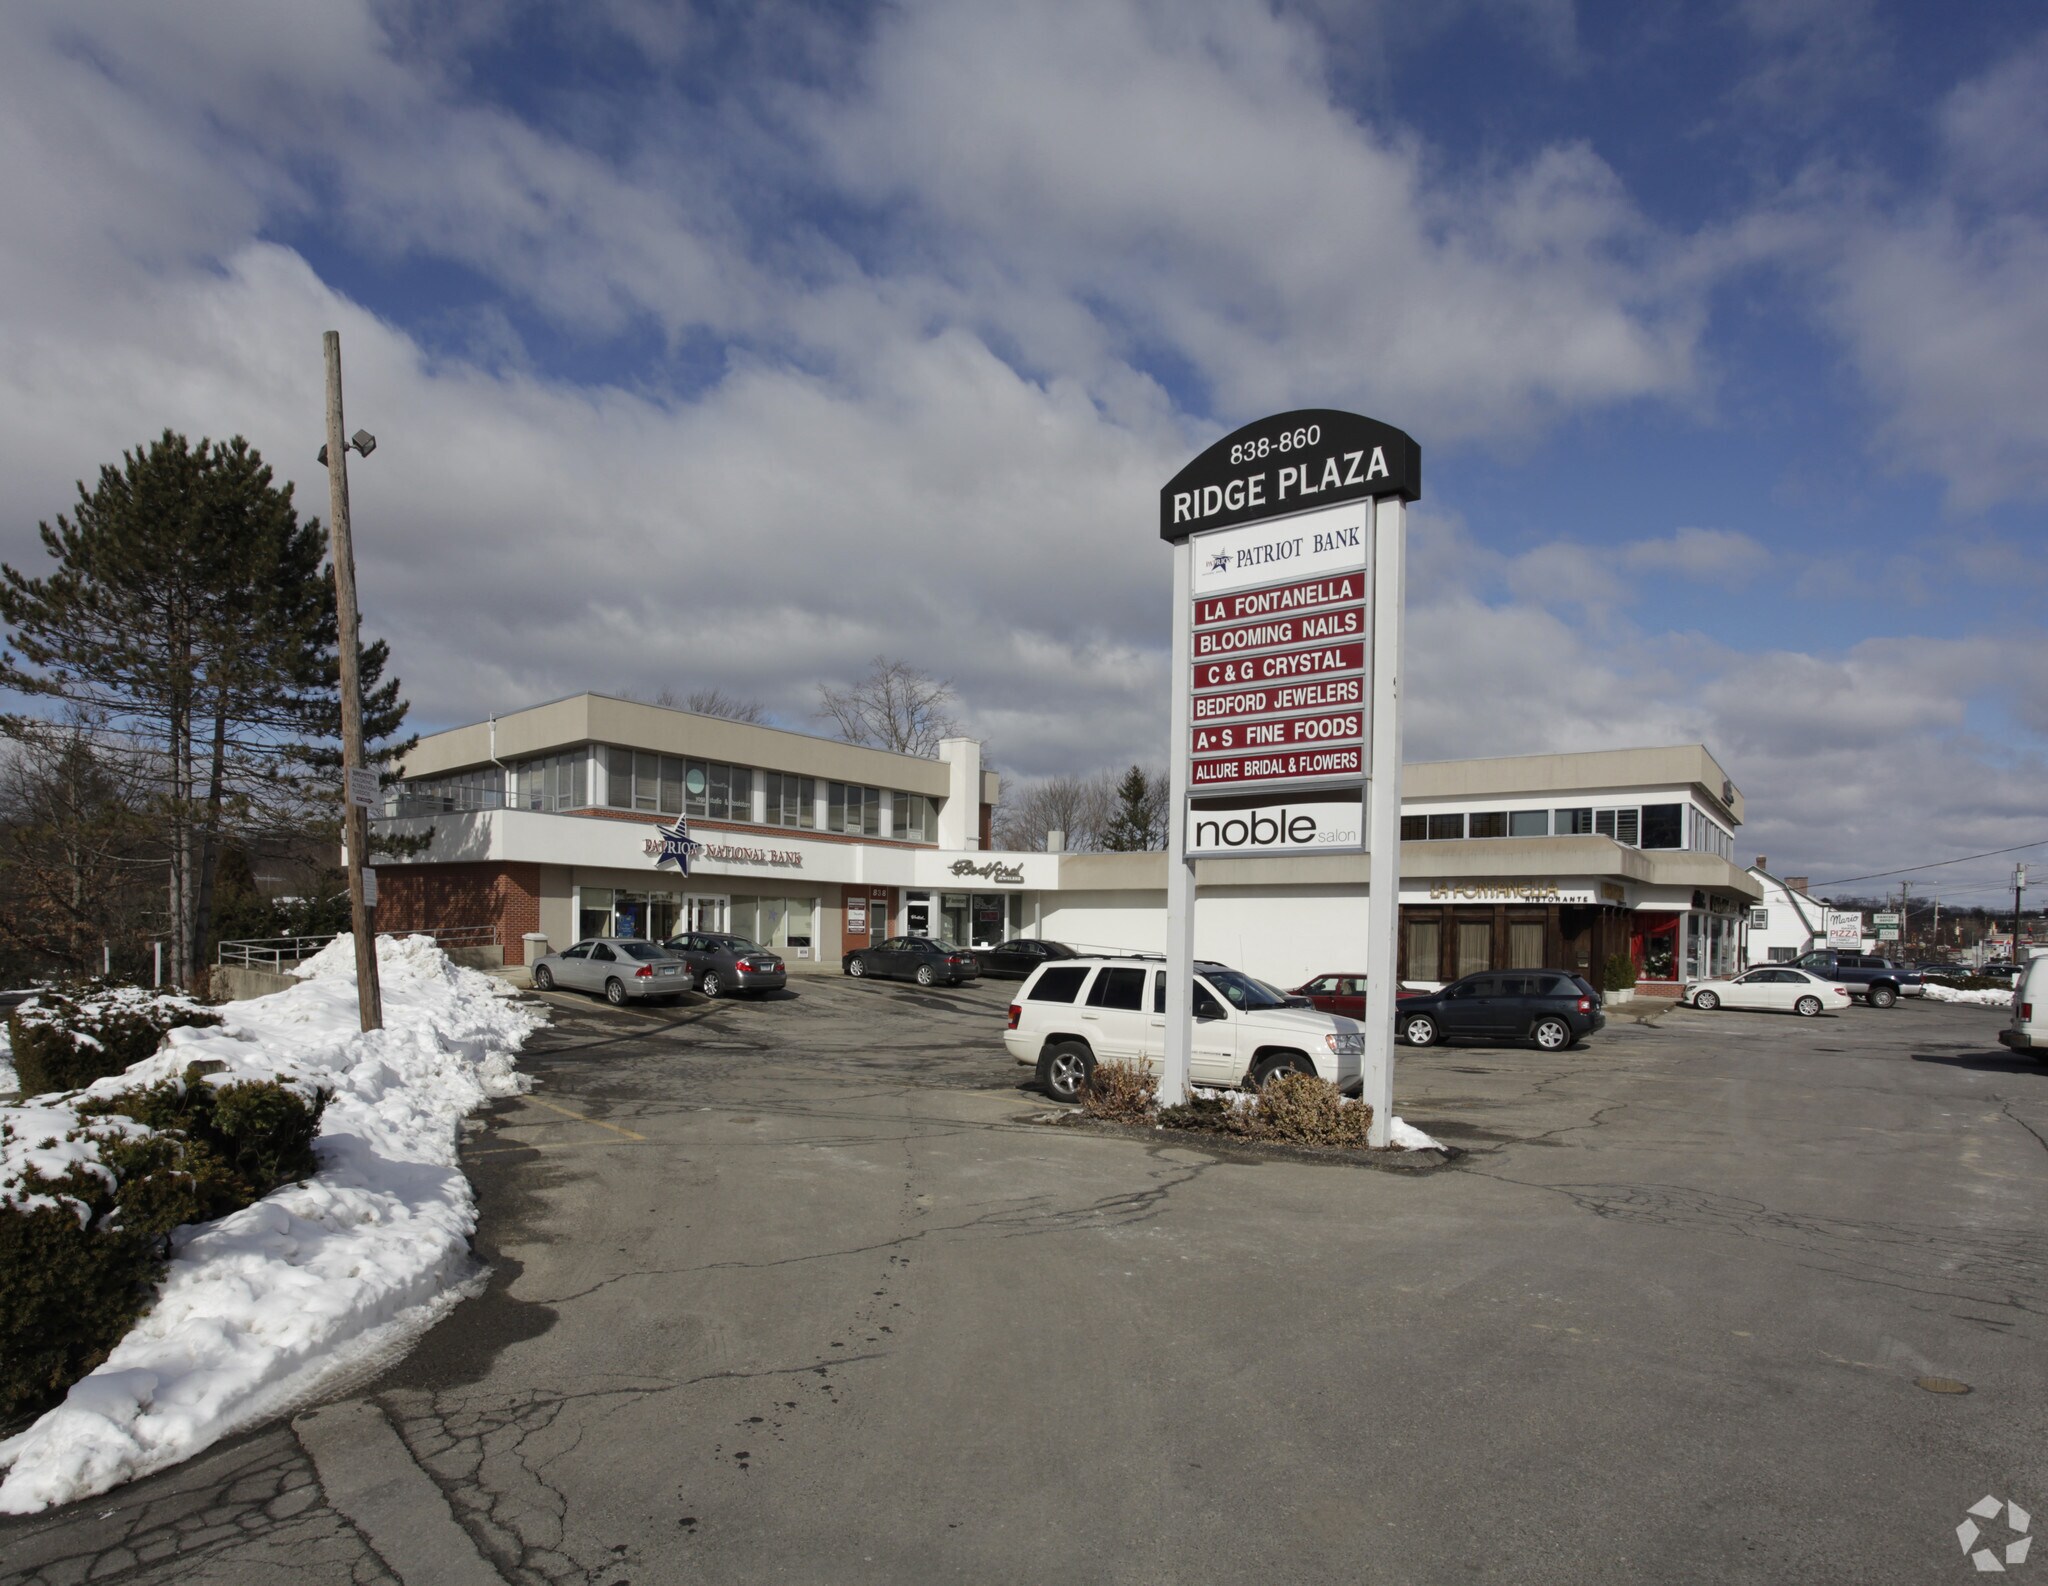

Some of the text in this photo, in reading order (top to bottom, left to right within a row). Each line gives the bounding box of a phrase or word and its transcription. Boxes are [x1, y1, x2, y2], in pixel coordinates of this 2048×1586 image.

[1230, 425, 1321, 465] 838-860
[1173, 446, 1389, 523] RIDGE PLAZA
[1237, 527, 1360, 568] PATRIOT BANK
[1204, 579, 1353, 621] LA FONTANELLA
[1200, 612, 1357, 653] BLOOMING NAILS
[1208, 650, 1347, 684] C & G CRYSTAL
[1196, 681, 1359, 717] BEDFORD JEWELERS
[1246, 723, 1285, 745] FINE
[1294, 716, 1358, 740] FOODS
[1196, 751, 1358, 780] ALLURE BRIDAL & FLOWERS
[1196, 808, 1356, 847] noble salon
[645, 838, 801, 864] PATRIOT NATIONAL BANK
[949, 859, 1024, 880] Bedford
[872, 889, 887, 897] 838
[1430, 879, 1559, 899] LA FONTANELLA
[1830, 914, 1859, 925] Mario
